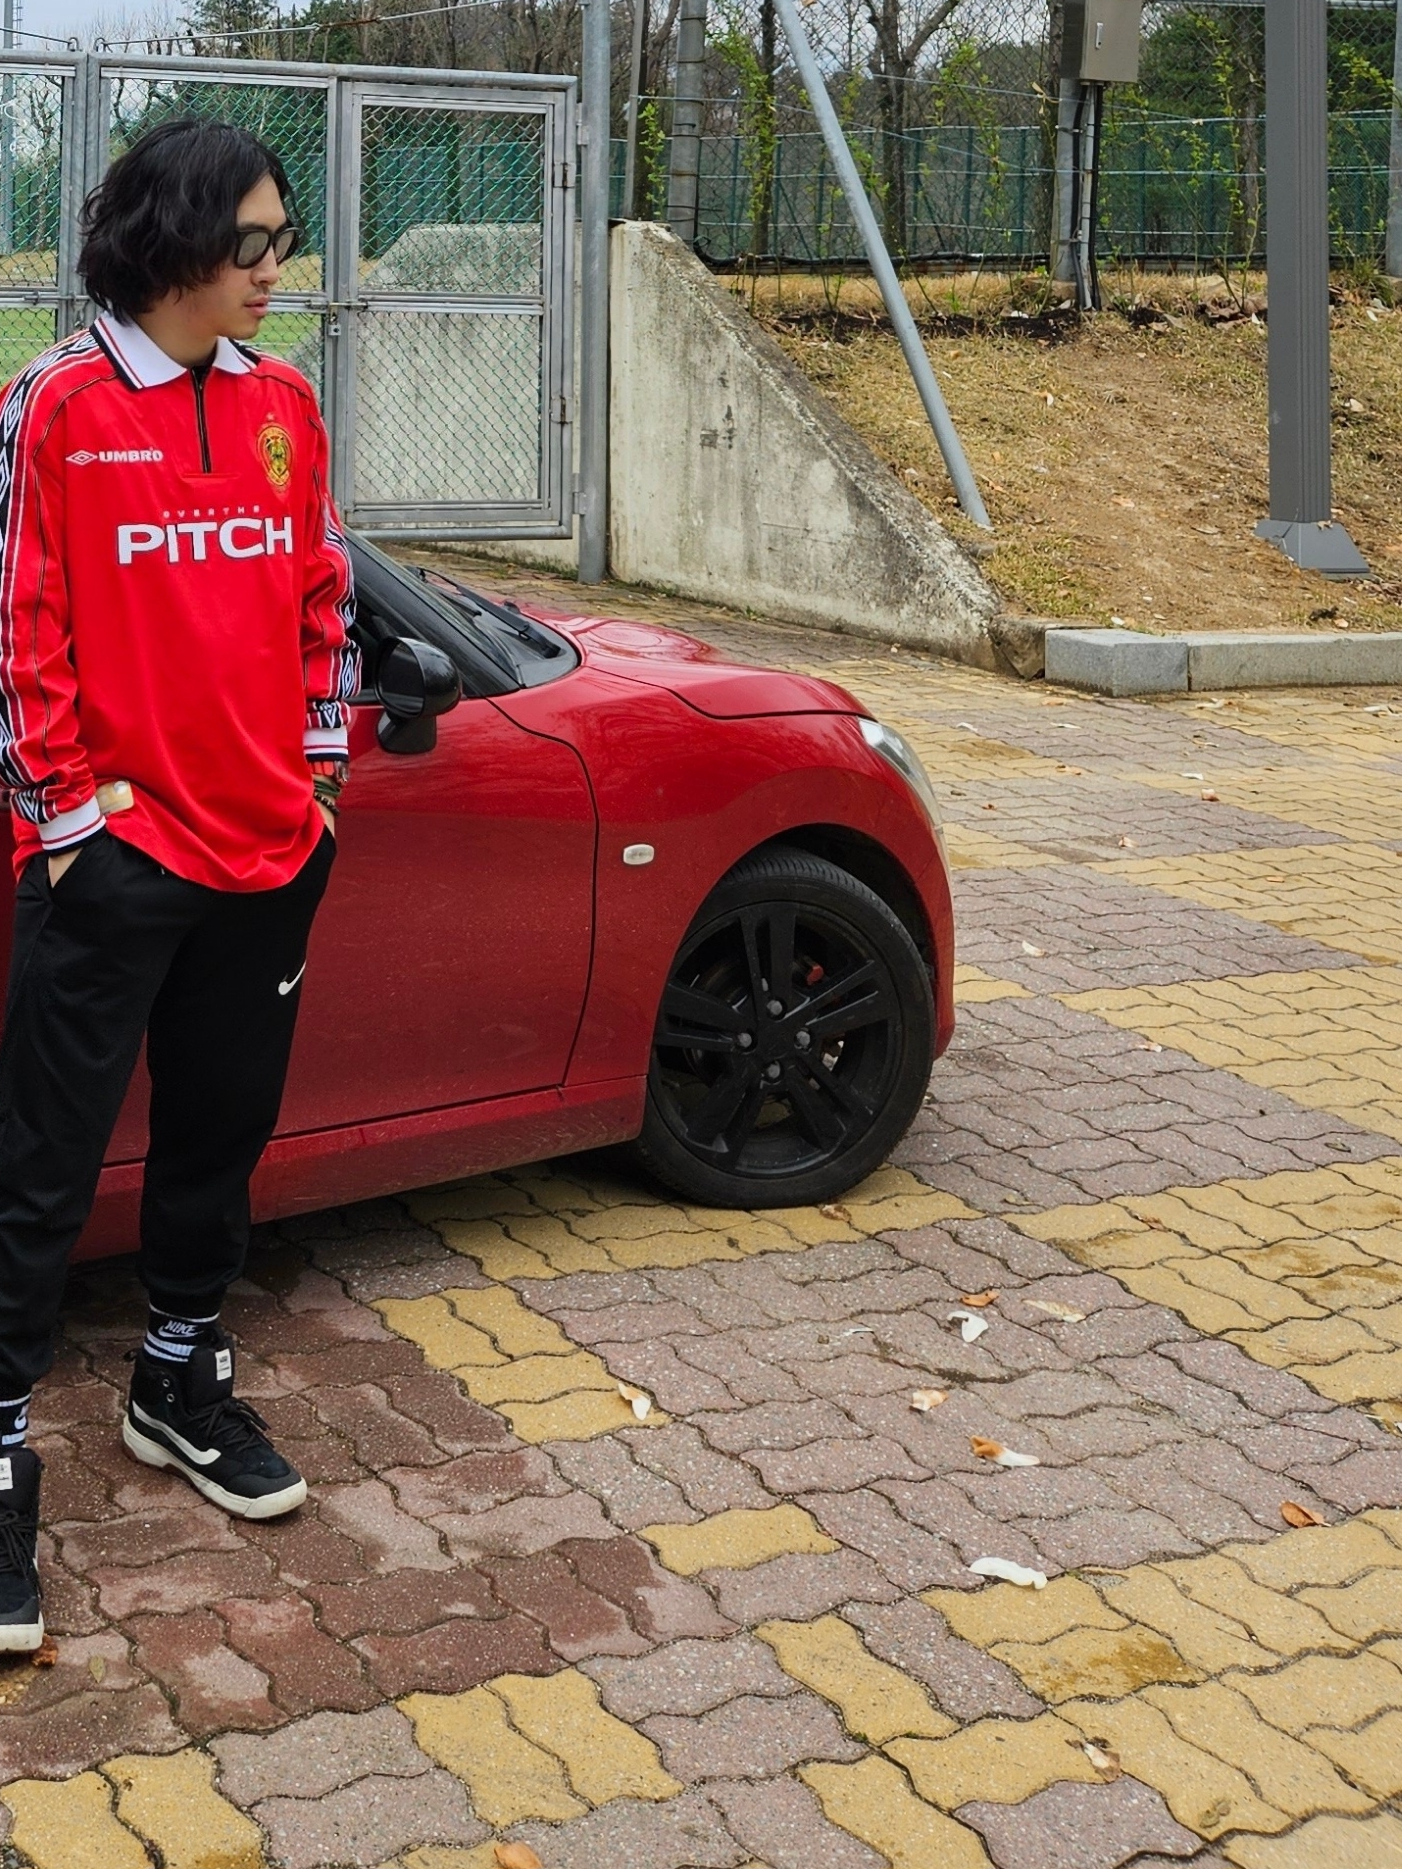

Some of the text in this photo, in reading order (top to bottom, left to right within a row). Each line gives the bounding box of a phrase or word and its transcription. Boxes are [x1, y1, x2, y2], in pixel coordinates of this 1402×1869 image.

[99, 447, 164, 463] UMBRO
[117, 516, 294, 566] PITCH
[164, 1320, 198, 1335] NIKE
